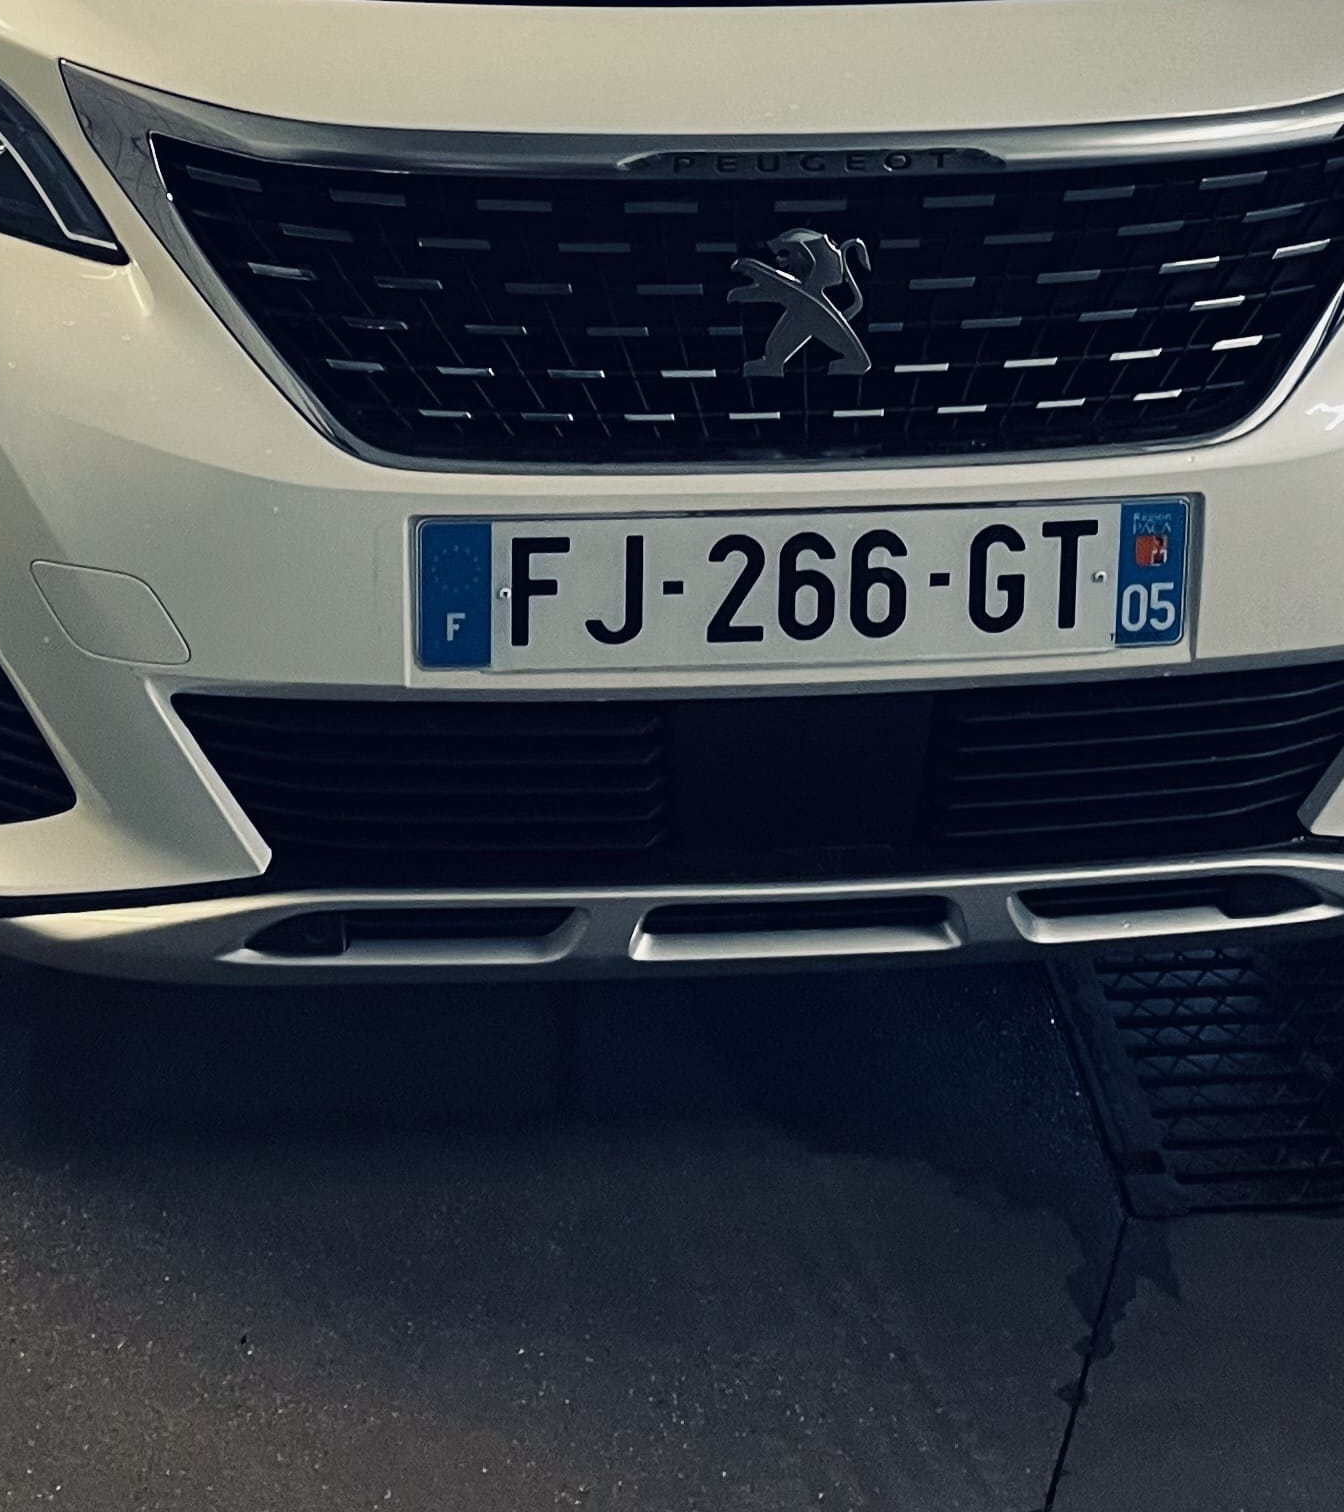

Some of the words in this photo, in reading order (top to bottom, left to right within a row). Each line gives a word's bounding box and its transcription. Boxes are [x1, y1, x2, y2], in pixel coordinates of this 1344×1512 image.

[672, 150, 955, 174] PEUGEOT
[510, 519, 1099, 647] FJ-266-GT
[446, 612, 466, 641] F
[1121, 581, 1176, 632] 05
